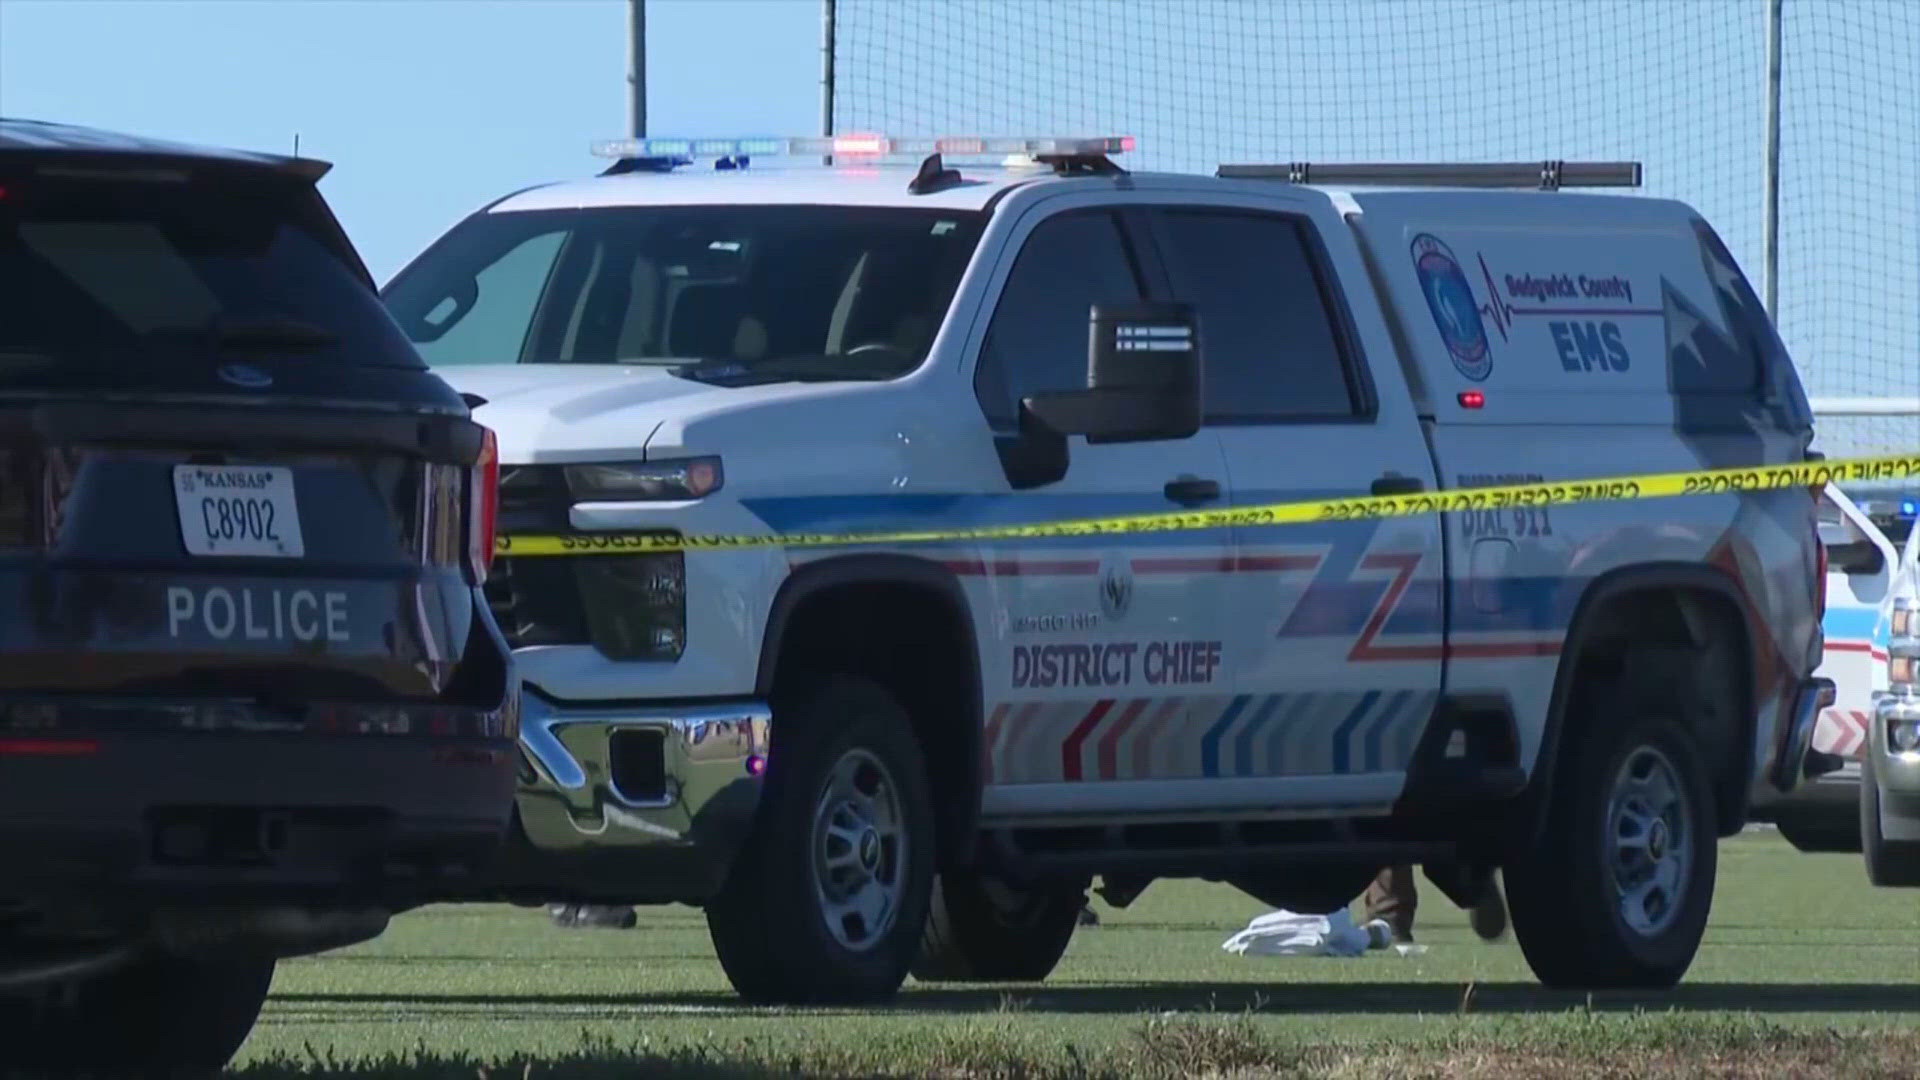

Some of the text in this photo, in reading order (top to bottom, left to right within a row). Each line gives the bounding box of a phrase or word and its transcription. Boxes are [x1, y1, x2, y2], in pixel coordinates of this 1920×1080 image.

[1579, 274, 1633, 303] County
[1549, 321, 1630, 373] EMS
[203, 472, 266, 489] KANSAS
[202, 496, 280, 540] C8902
[1462, 505, 1553, 537] DIAL 911
[167, 586, 350, 641] POLICE
[1011, 640, 1222, 689] DISTRICT CHIEF
